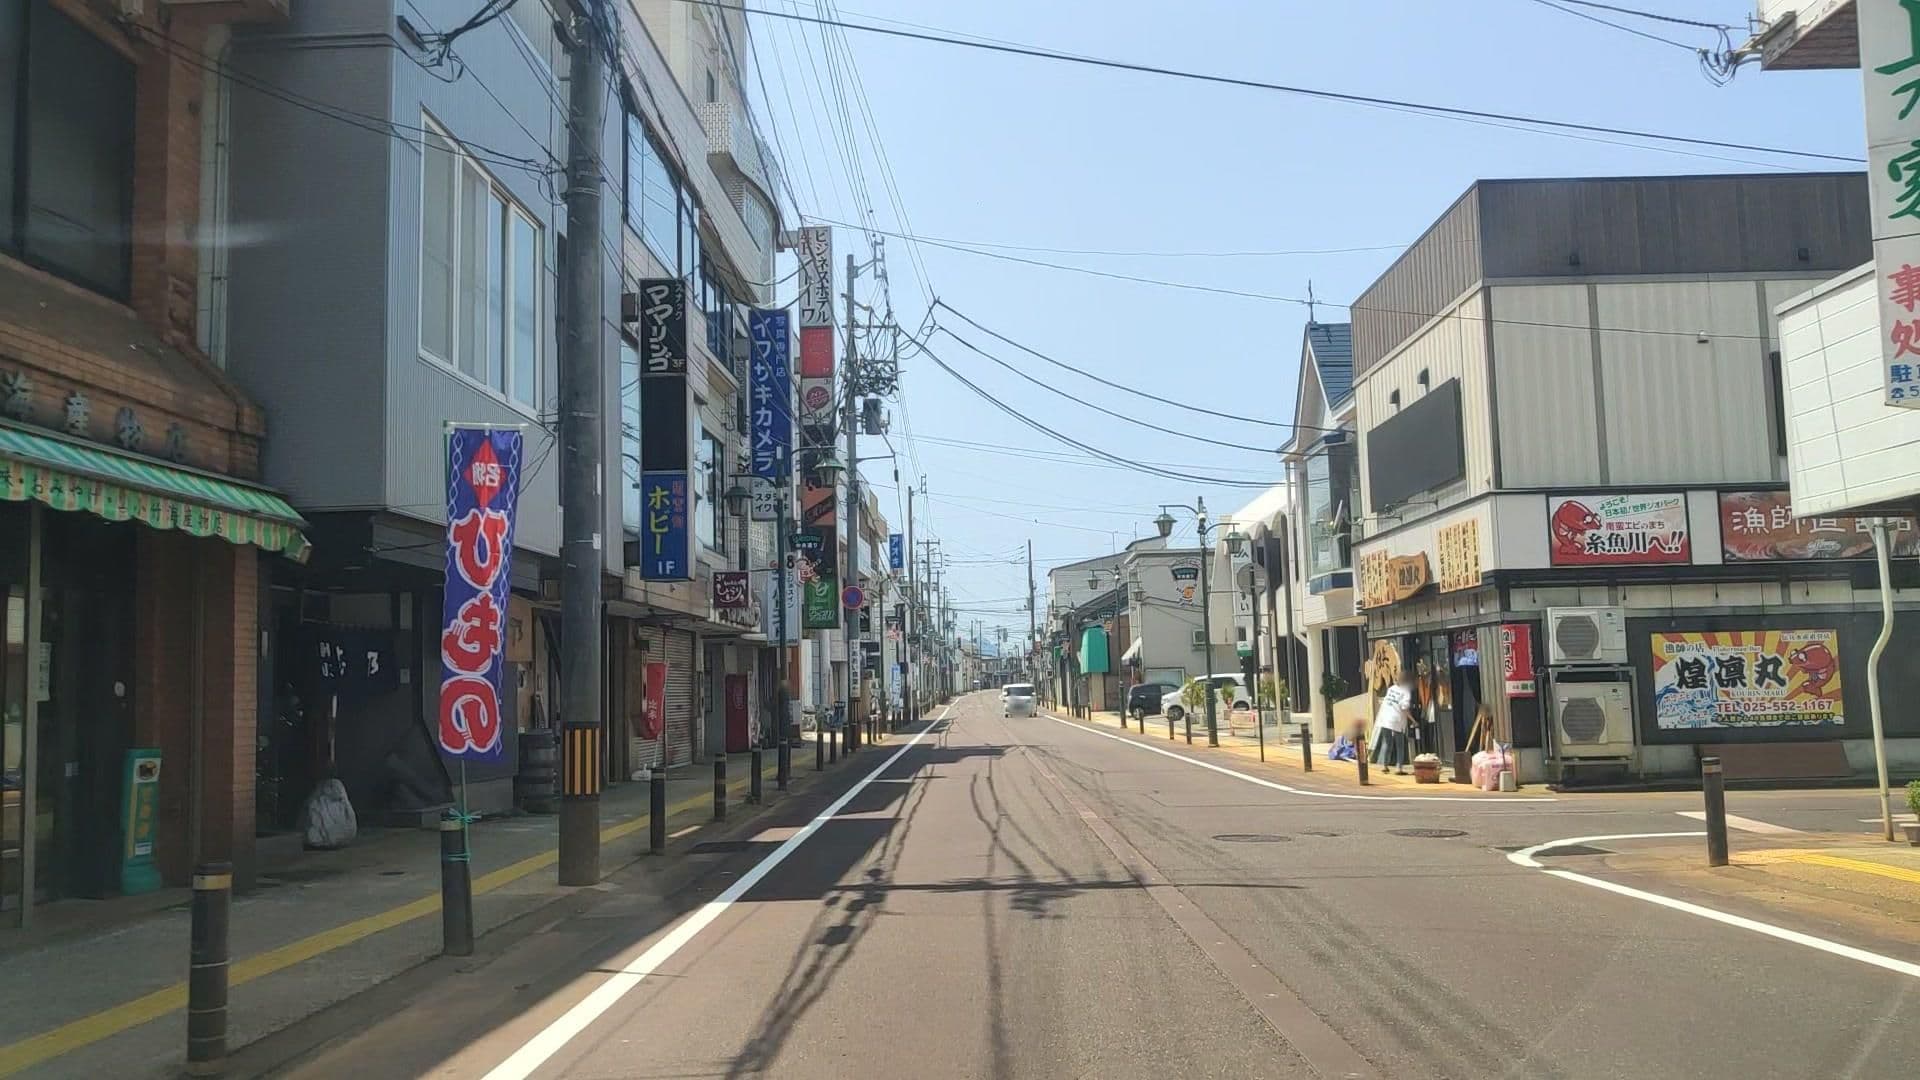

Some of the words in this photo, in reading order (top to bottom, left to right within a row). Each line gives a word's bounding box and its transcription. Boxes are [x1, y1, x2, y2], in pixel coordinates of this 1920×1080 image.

[816, 229, 829, 323] ビジネスホテル
[646, 285, 672, 371] ママリンゴ
[673, 358, 685, 368] 3F
[1891, 364, 1920, 383] 駐
[753, 317, 774, 472] イワサキカメラ
[648, 485, 671, 555] ホビー
[1586, 531, 1684, 554] 糸魚川へ!!
[1718, 703, 1741, 713] TEL
[1744, 701, 1832, 711] 025-552-1167
